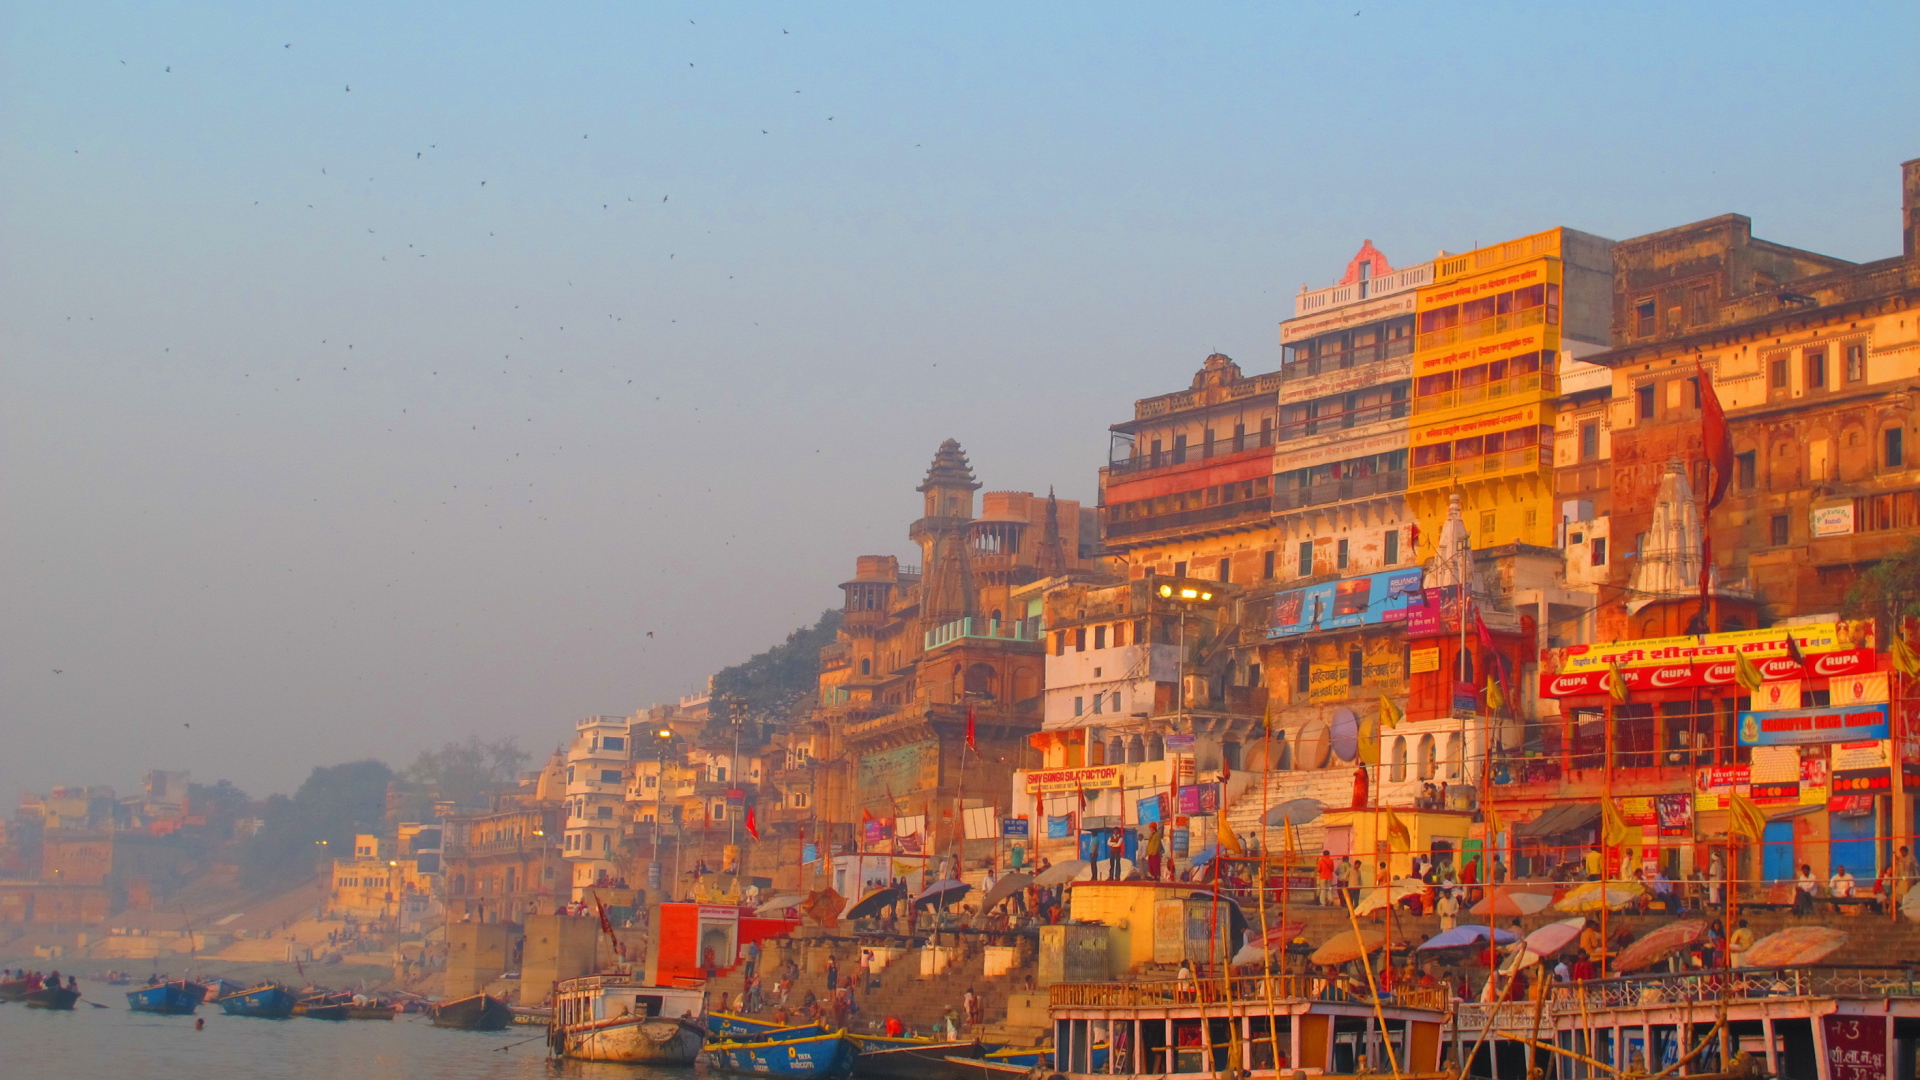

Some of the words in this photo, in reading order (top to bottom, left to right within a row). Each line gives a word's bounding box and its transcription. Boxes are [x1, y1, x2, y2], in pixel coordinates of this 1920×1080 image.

[1826, 655, 1858, 666] RUPA
[1661, 668, 1691, 678] RUPA
[1715, 666, 1736, 675] RUP
[1560, 677, 1588, 687] RUPA
[1333, 684, 1348, 696] GHAT
[1043, 771, 1064, 783] GANGA
[1065, 770, 1080, 781] SILK
[1081, 768, 1117, 780] FACTORY
